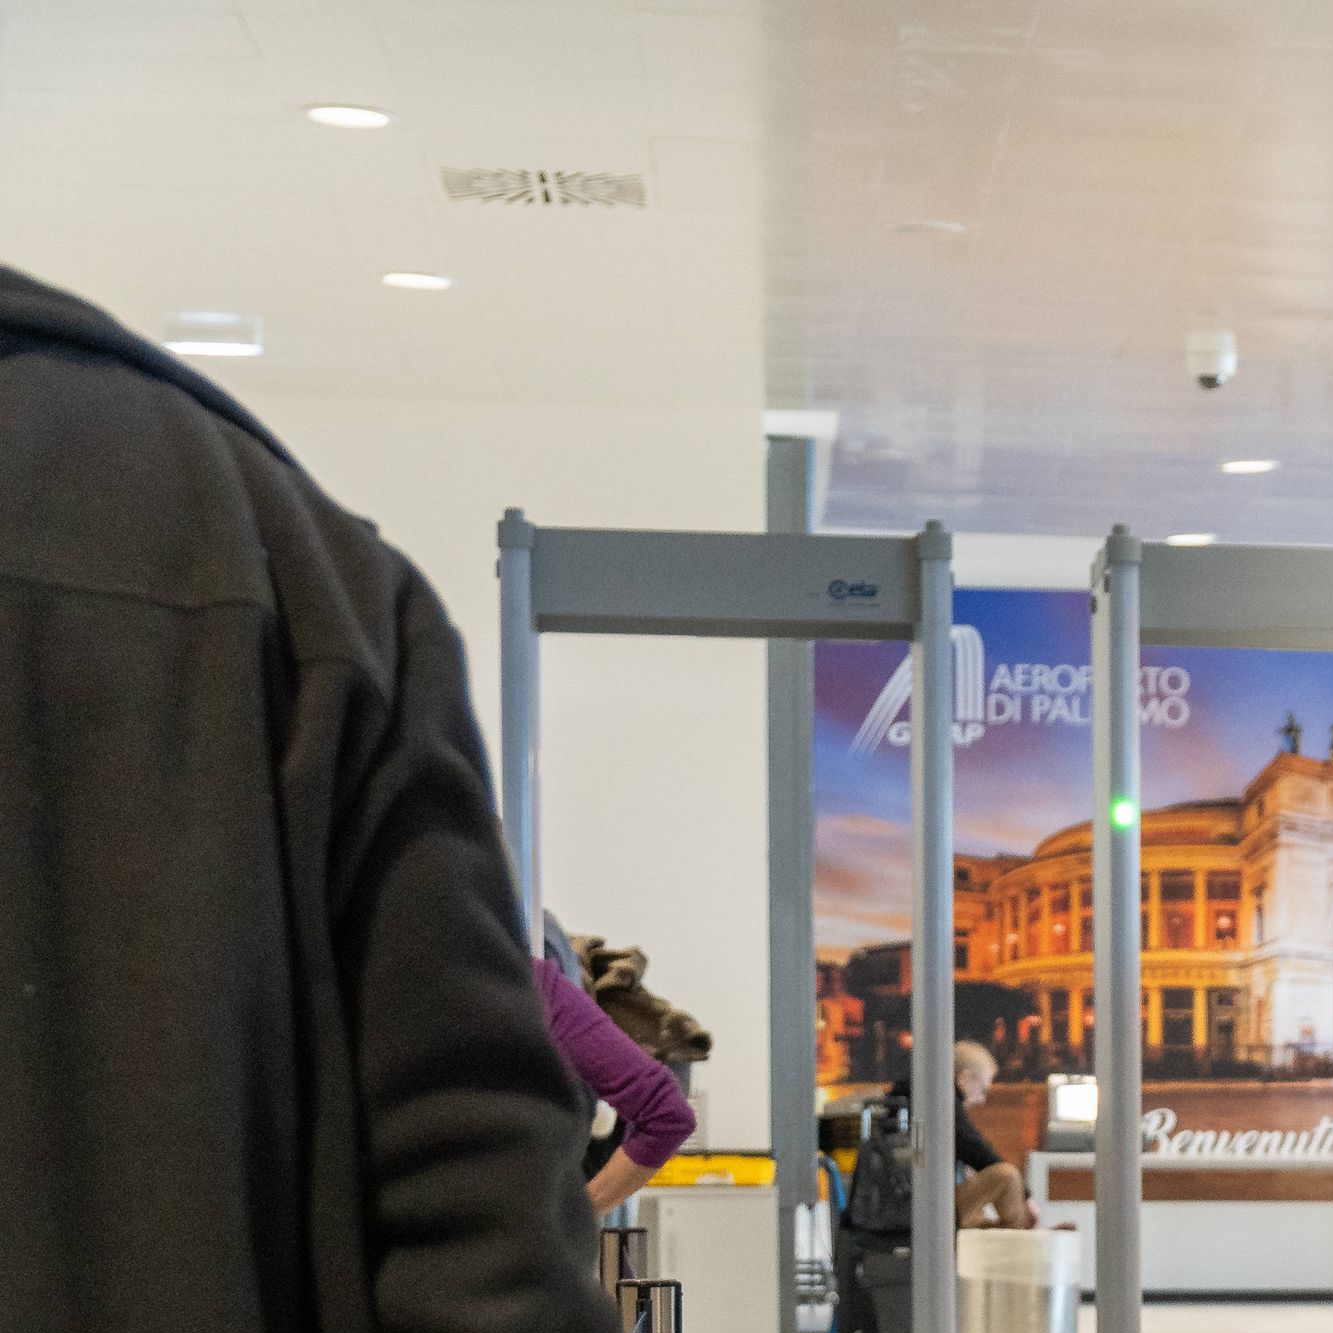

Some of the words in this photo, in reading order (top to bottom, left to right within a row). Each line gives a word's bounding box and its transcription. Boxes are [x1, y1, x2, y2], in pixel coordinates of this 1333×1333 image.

[991, 664, 1191, 697] AEROPTO
[988, 695, 1021, 724] DI
[1031, 695, 1191, 727] PALMO
